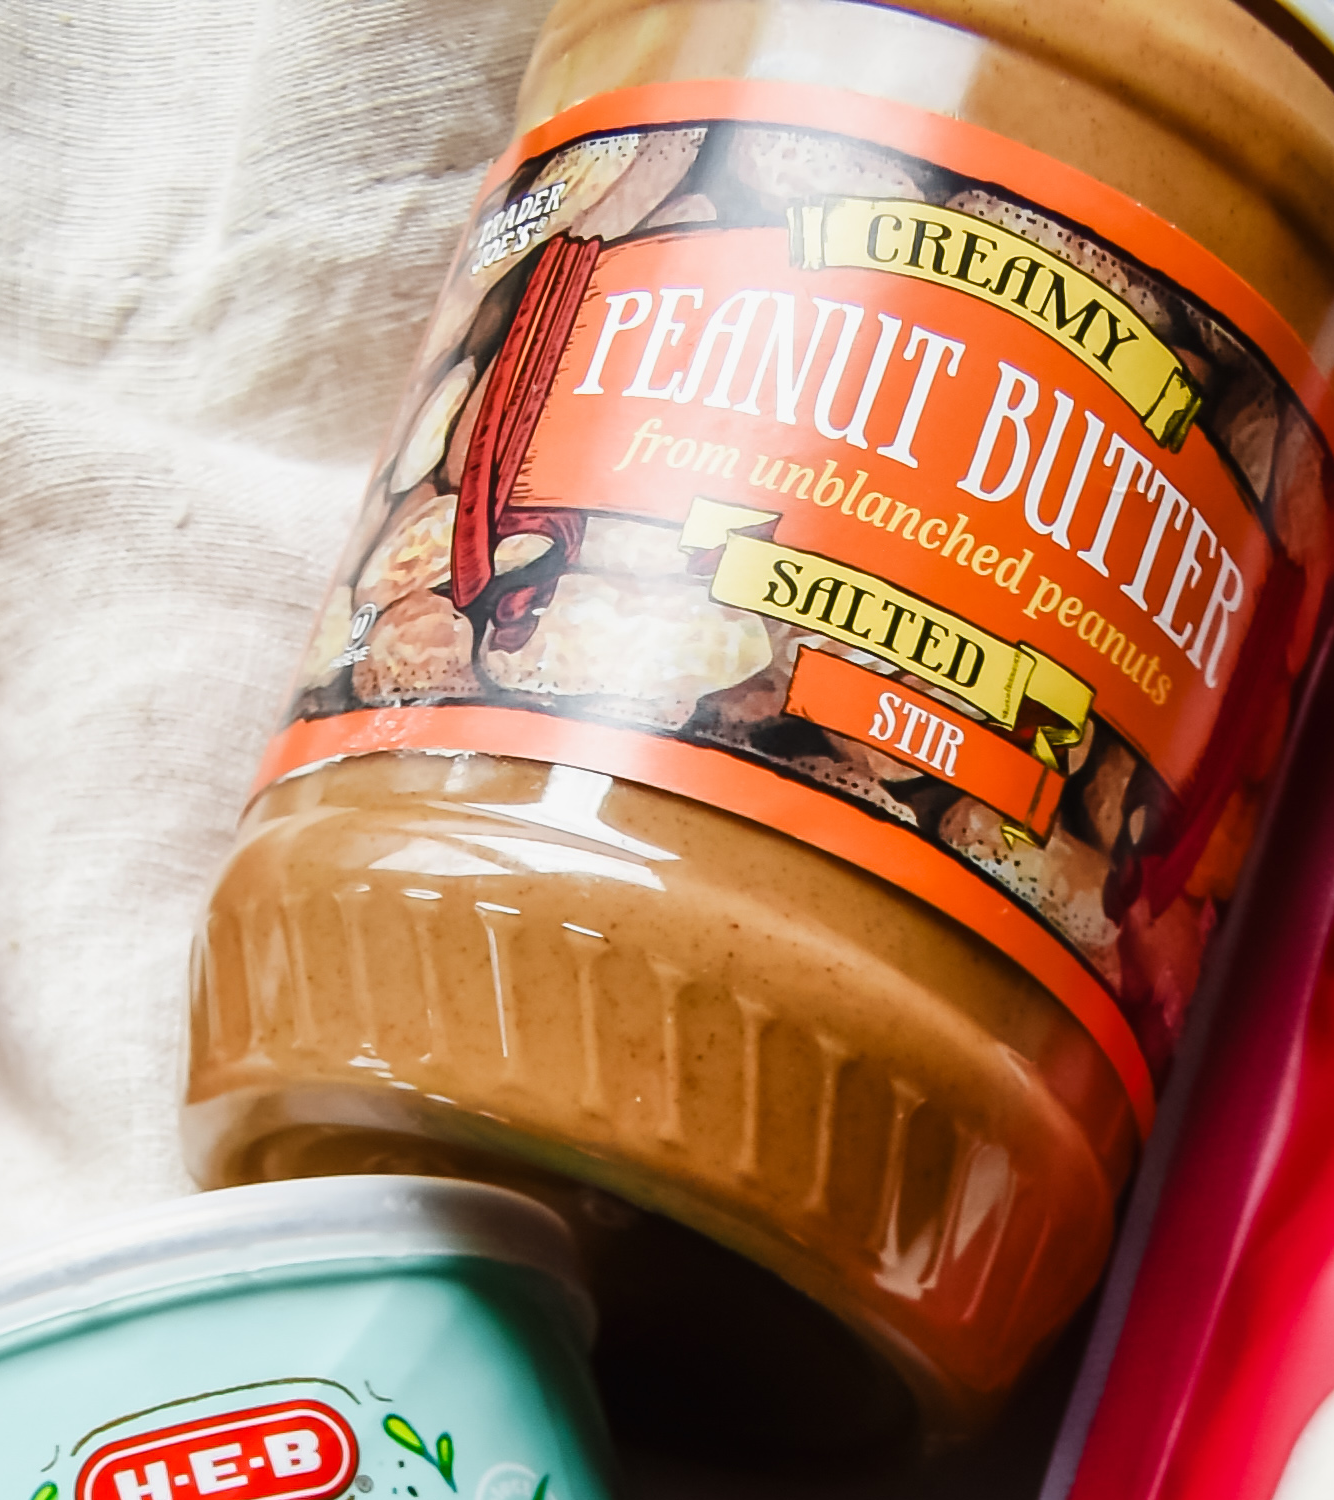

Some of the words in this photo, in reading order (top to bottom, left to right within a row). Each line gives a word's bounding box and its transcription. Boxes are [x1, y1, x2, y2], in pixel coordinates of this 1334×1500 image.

[866, 211, 1139, 373] CREAMY
[574, 286, 967, 470] PEANUT
[957, 359, 1247, 690] BUTTER
[614, 418, 740, 479] from
[748, 446, 1035, 595] unblanched
[1021, 573, 1174, 707] peanuts
[761, 558, 986, 690] SALTED
[867, 691, 966, 779] STIR
